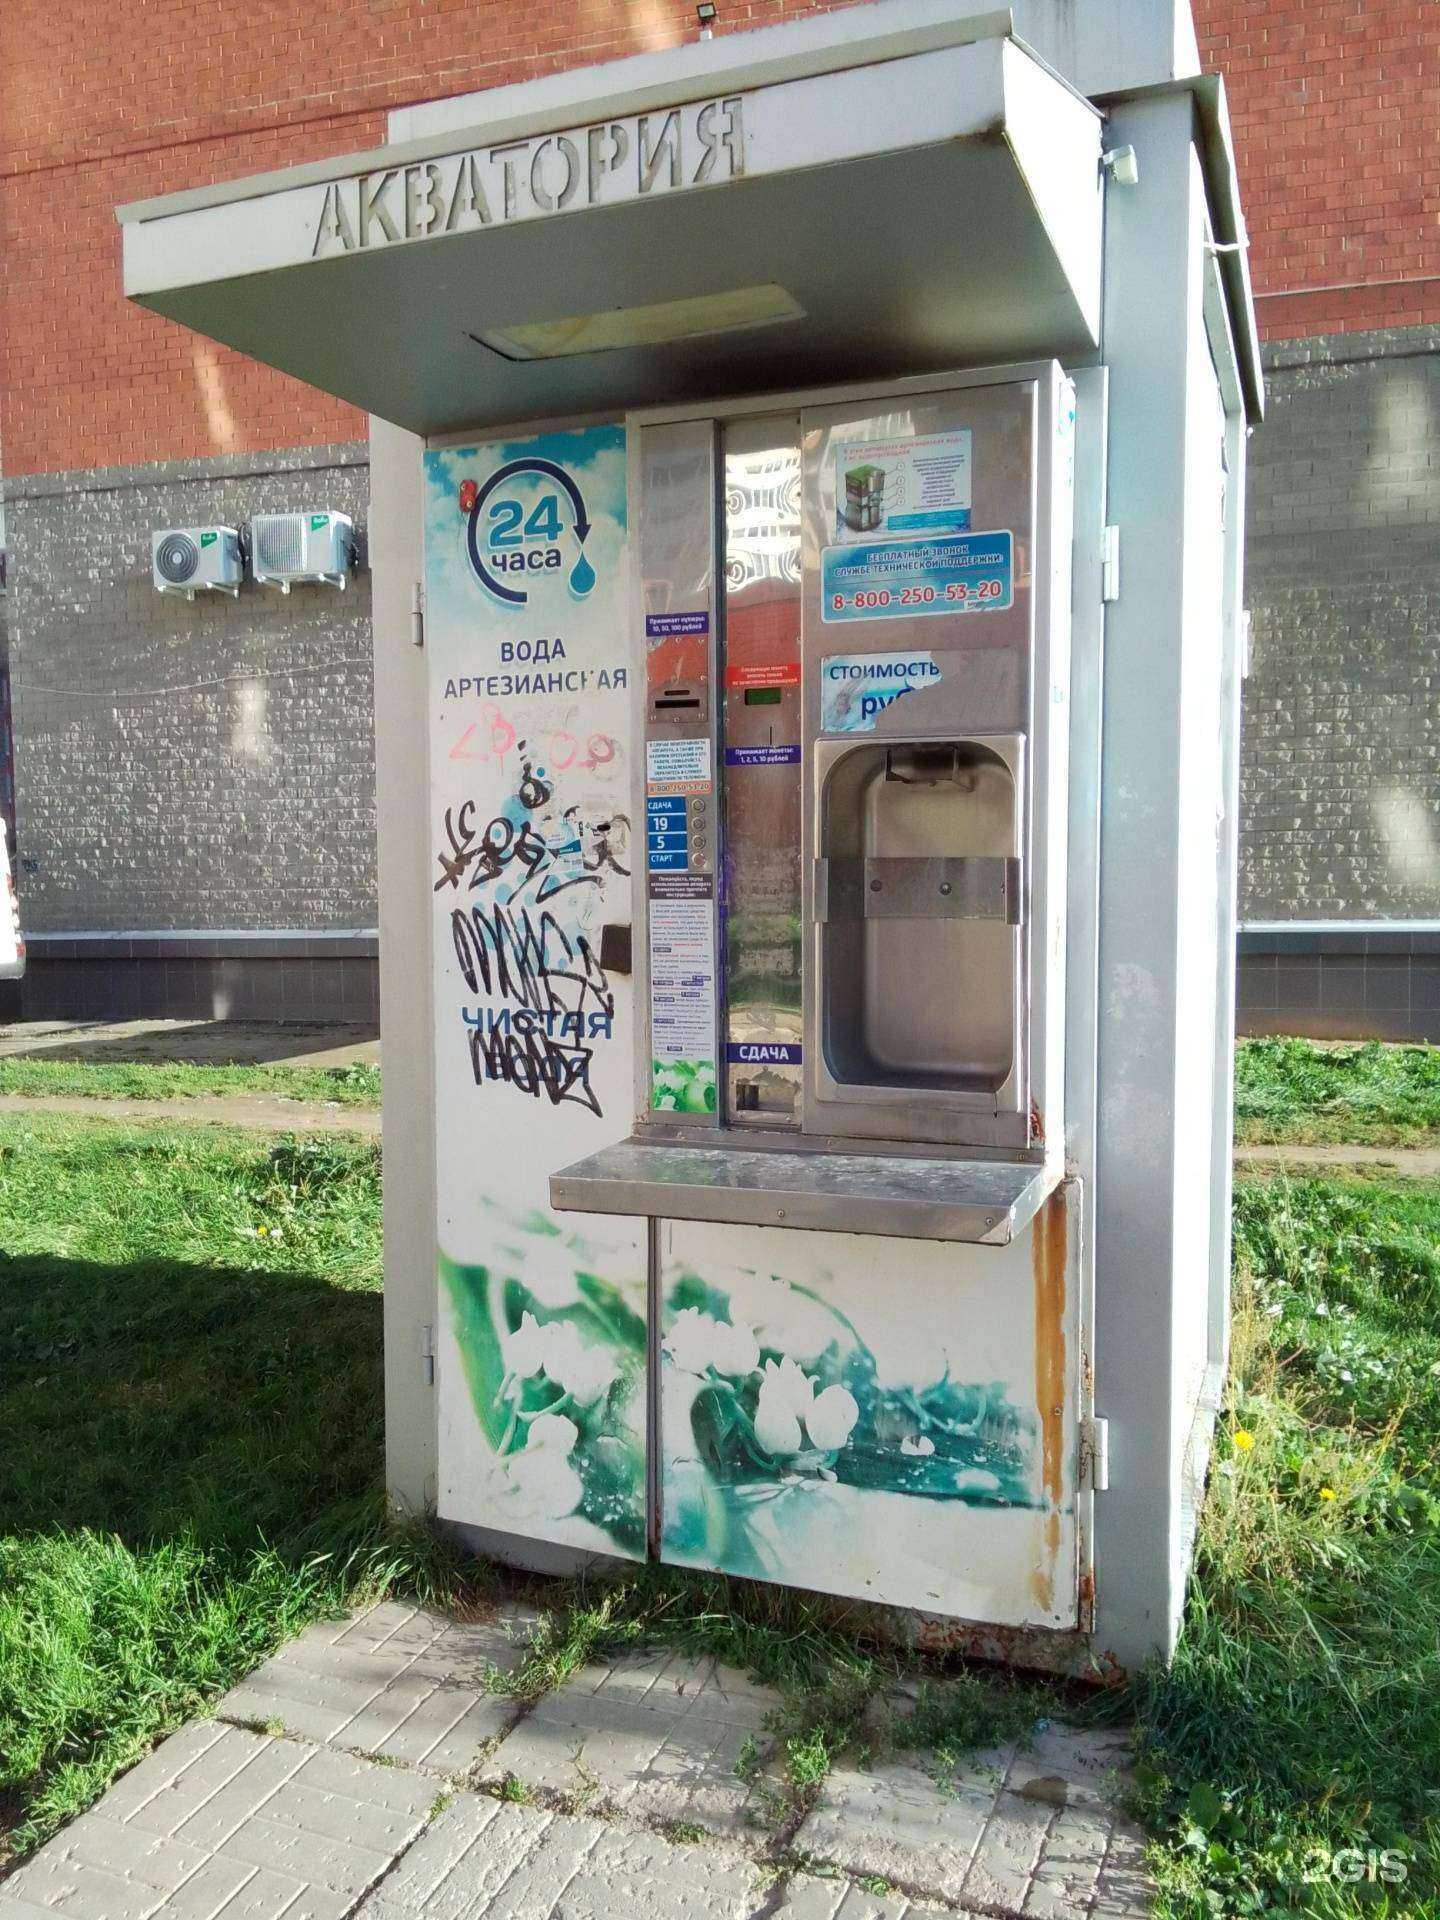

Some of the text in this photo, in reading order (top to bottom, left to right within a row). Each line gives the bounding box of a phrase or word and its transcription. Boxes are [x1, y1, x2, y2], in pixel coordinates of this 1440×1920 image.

[312, 97, 744, 257] АКВАТОРИЯ
[488, 494, 564, 548] 24
[491, 548, 562, 572] часа
[867, 544, 969, 563] БЕСПЛАТНЫЙ ЗВОНОК
[834, 553, 1003, 577] СЛУЖБЕ ТЕХНИЧЕСКОЙ ПОДДЕРЖКИ
[833, 581, 1002, 610] 8-800-250-53-20
[501, 638, 566, 664] ВОДА
[829, 662, 940, 680] СТОИМОСТЬ
[648, 801, 672, 810] СДАЧА
[653, 817, 668, 831] 19
[657, 836, 665, 849] 5
[651, 855, 673, 863] СТАРТ
[462, 1006, 612, 1040] ЧИСТАЯ
[739, 1046, 789, 1061] СДАЧА
